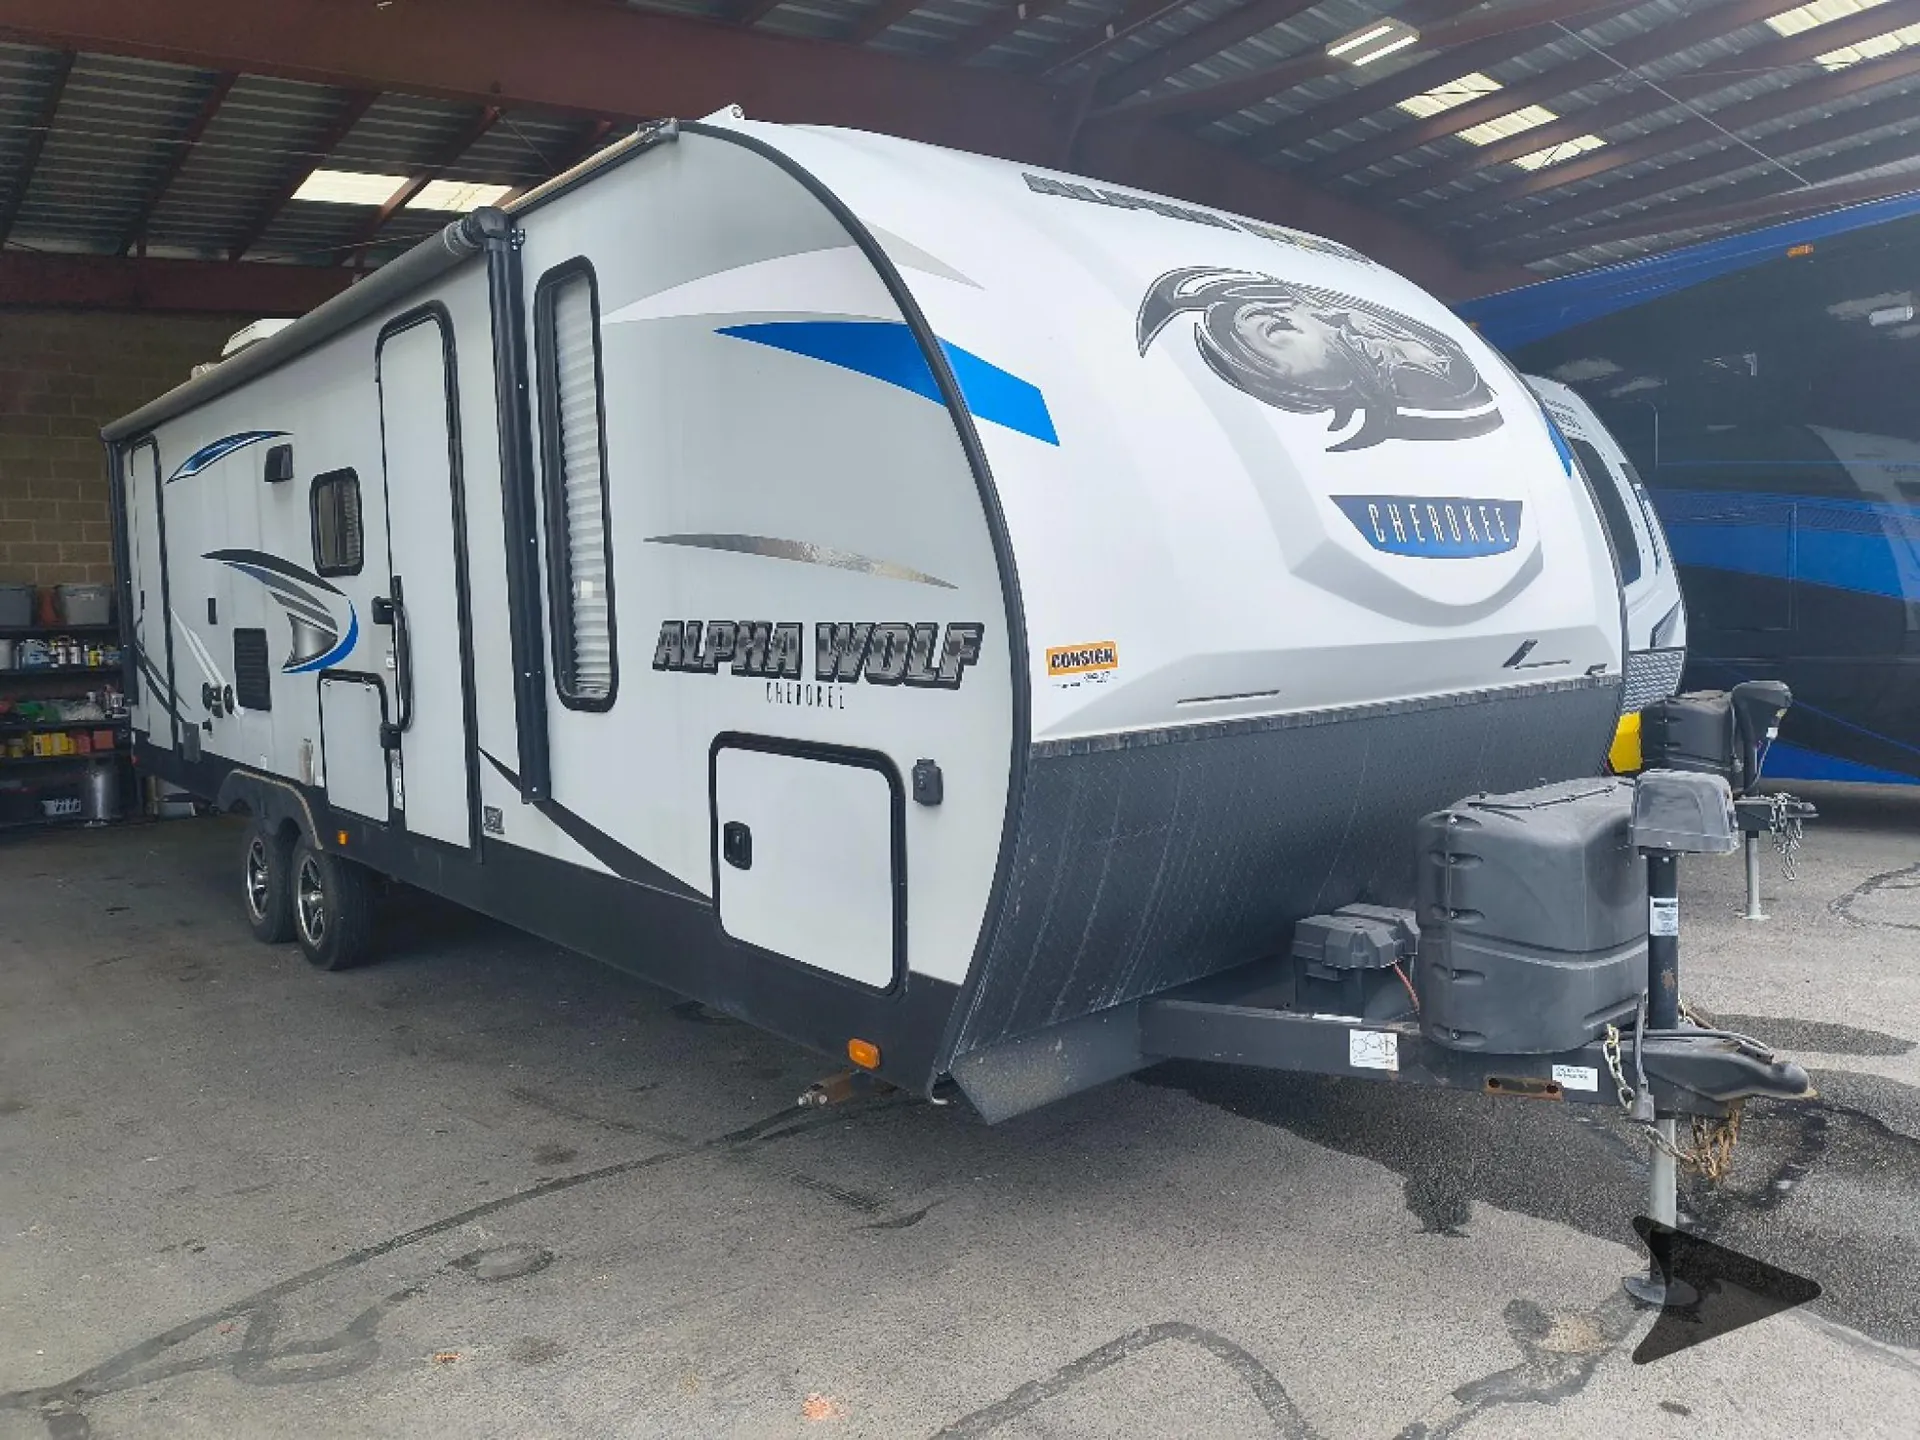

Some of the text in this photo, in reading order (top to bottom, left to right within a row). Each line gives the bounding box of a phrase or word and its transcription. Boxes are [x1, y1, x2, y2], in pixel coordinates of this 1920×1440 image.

[1368, 503, 1510, 542] CHEROKEE
[652, 620, 985, 690] ALPHA WOLF
[1051, 648, 1114, 668] CONSIGN
[766, 682, 846, 710] CHEROKEE
